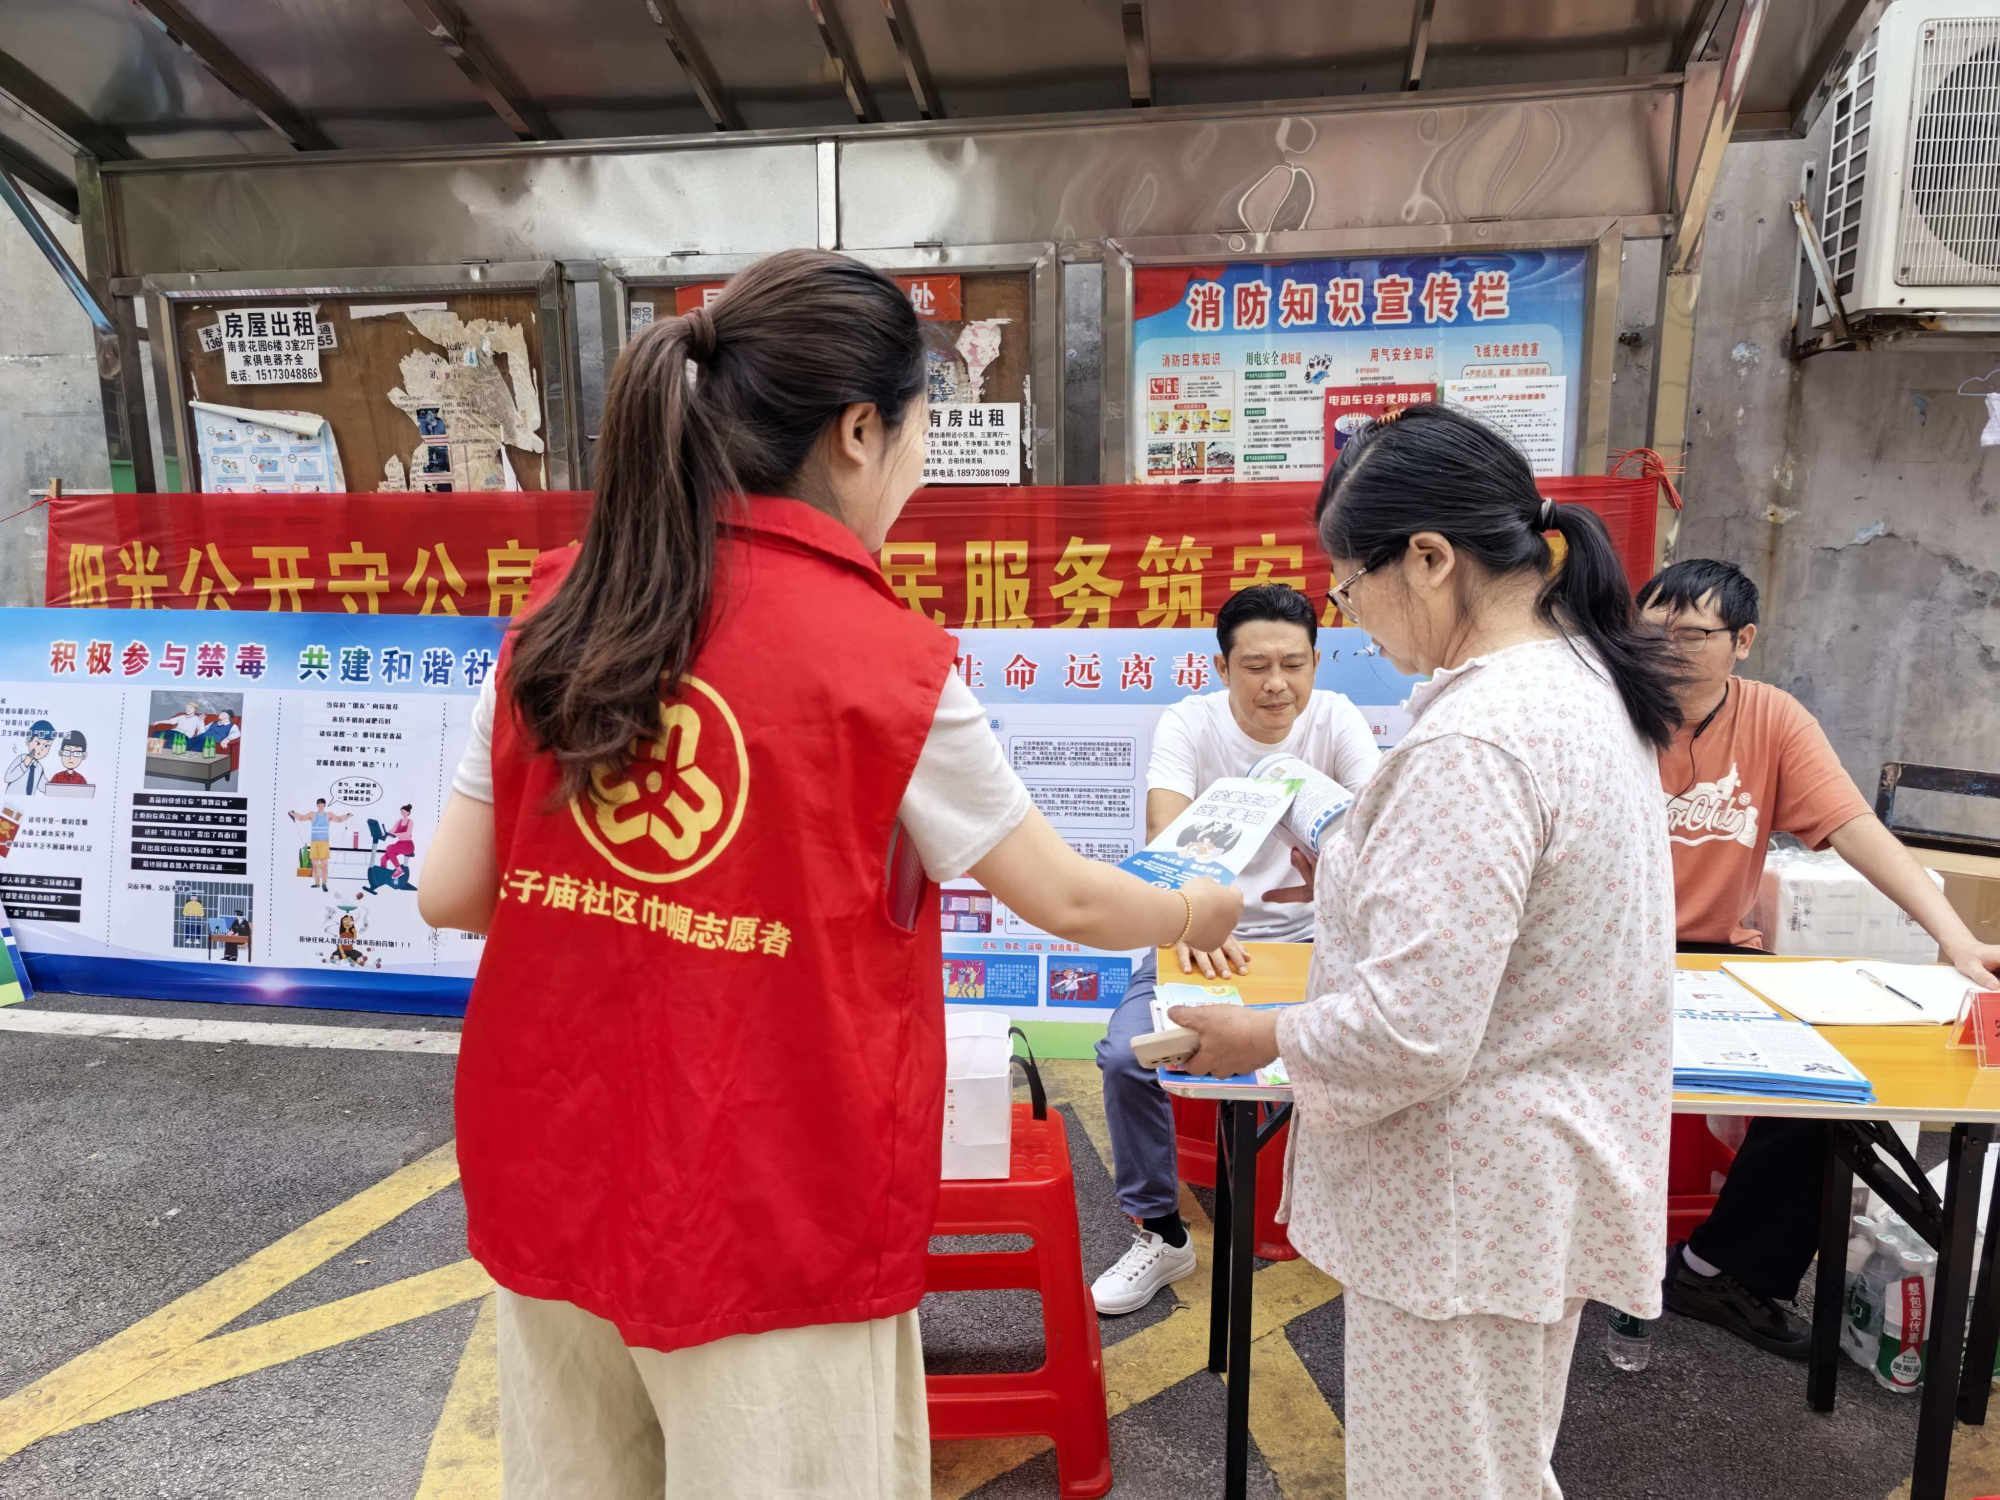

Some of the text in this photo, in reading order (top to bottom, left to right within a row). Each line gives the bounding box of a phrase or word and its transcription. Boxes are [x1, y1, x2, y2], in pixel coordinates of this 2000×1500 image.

[910, 282, 936, 315] 处
[1188, 272, 1509, 330] 消防知识宣传栏
[224, 311, 315, 338] 房屋出租
[227, 339, 316, 352] 南景花园6楼 3室2厅
[1472, 343, 1539, 358] 飞线充电的危害
[243, 353, 304, 366] 家俱电器齐全
[1162, 352, 1221, 367] 消防日常知识
[1370, 346, 1434, 362] 用气安全知识
[1328, 392, 1432, 406] 电动车安全使用指南
[50, 640, 497, 687] 积极参与禁毒 共建和谐社
[990, 719, 1000, 729] 品
[1907, 1282, 1922, 1344] 整包更优惠
